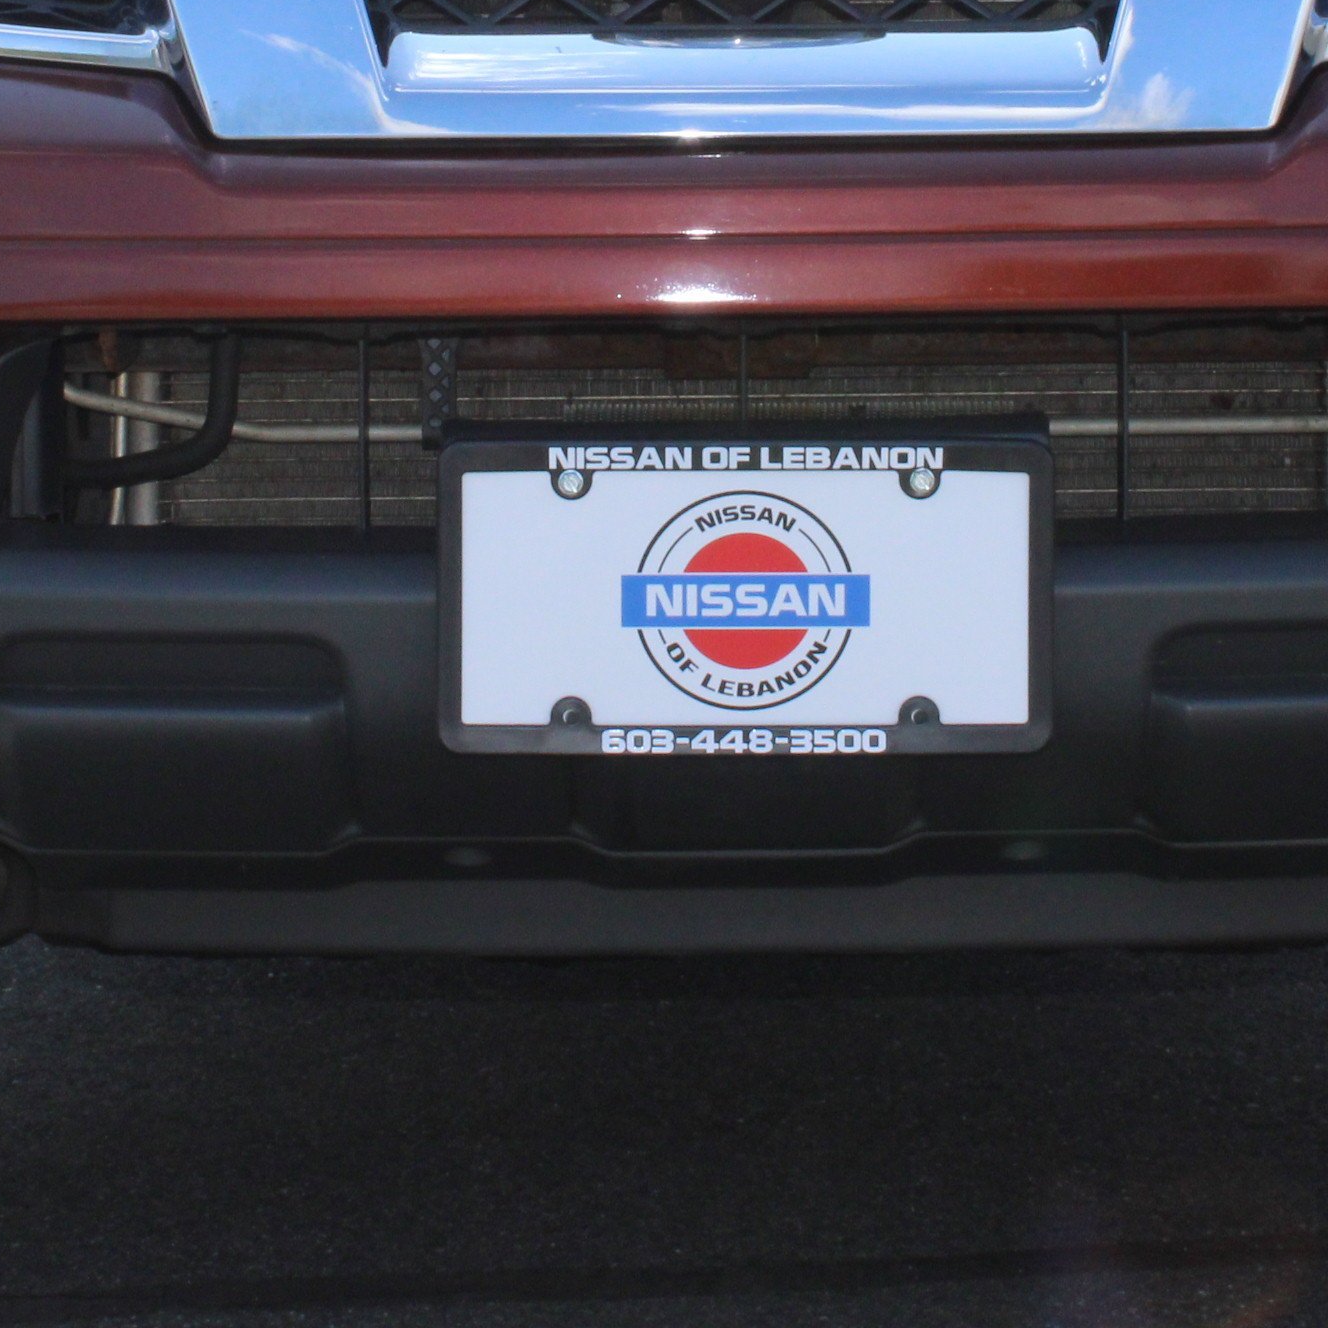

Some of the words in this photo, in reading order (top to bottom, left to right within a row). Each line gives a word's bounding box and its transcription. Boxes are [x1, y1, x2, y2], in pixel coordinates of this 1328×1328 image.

[548, 446, 692, 471] NISSAN
[701, 446, 752, 471] OF
[759, 446, 945, 471] LEBANON
[694, 504, 797, 533] NISSAN
[645, 583, 847, 618] NISSAN
[666, 641, 699, 673] OF
[700, 641, 828, 698] LEBANON
[600, 728, 888, 754] 603-448-3500
